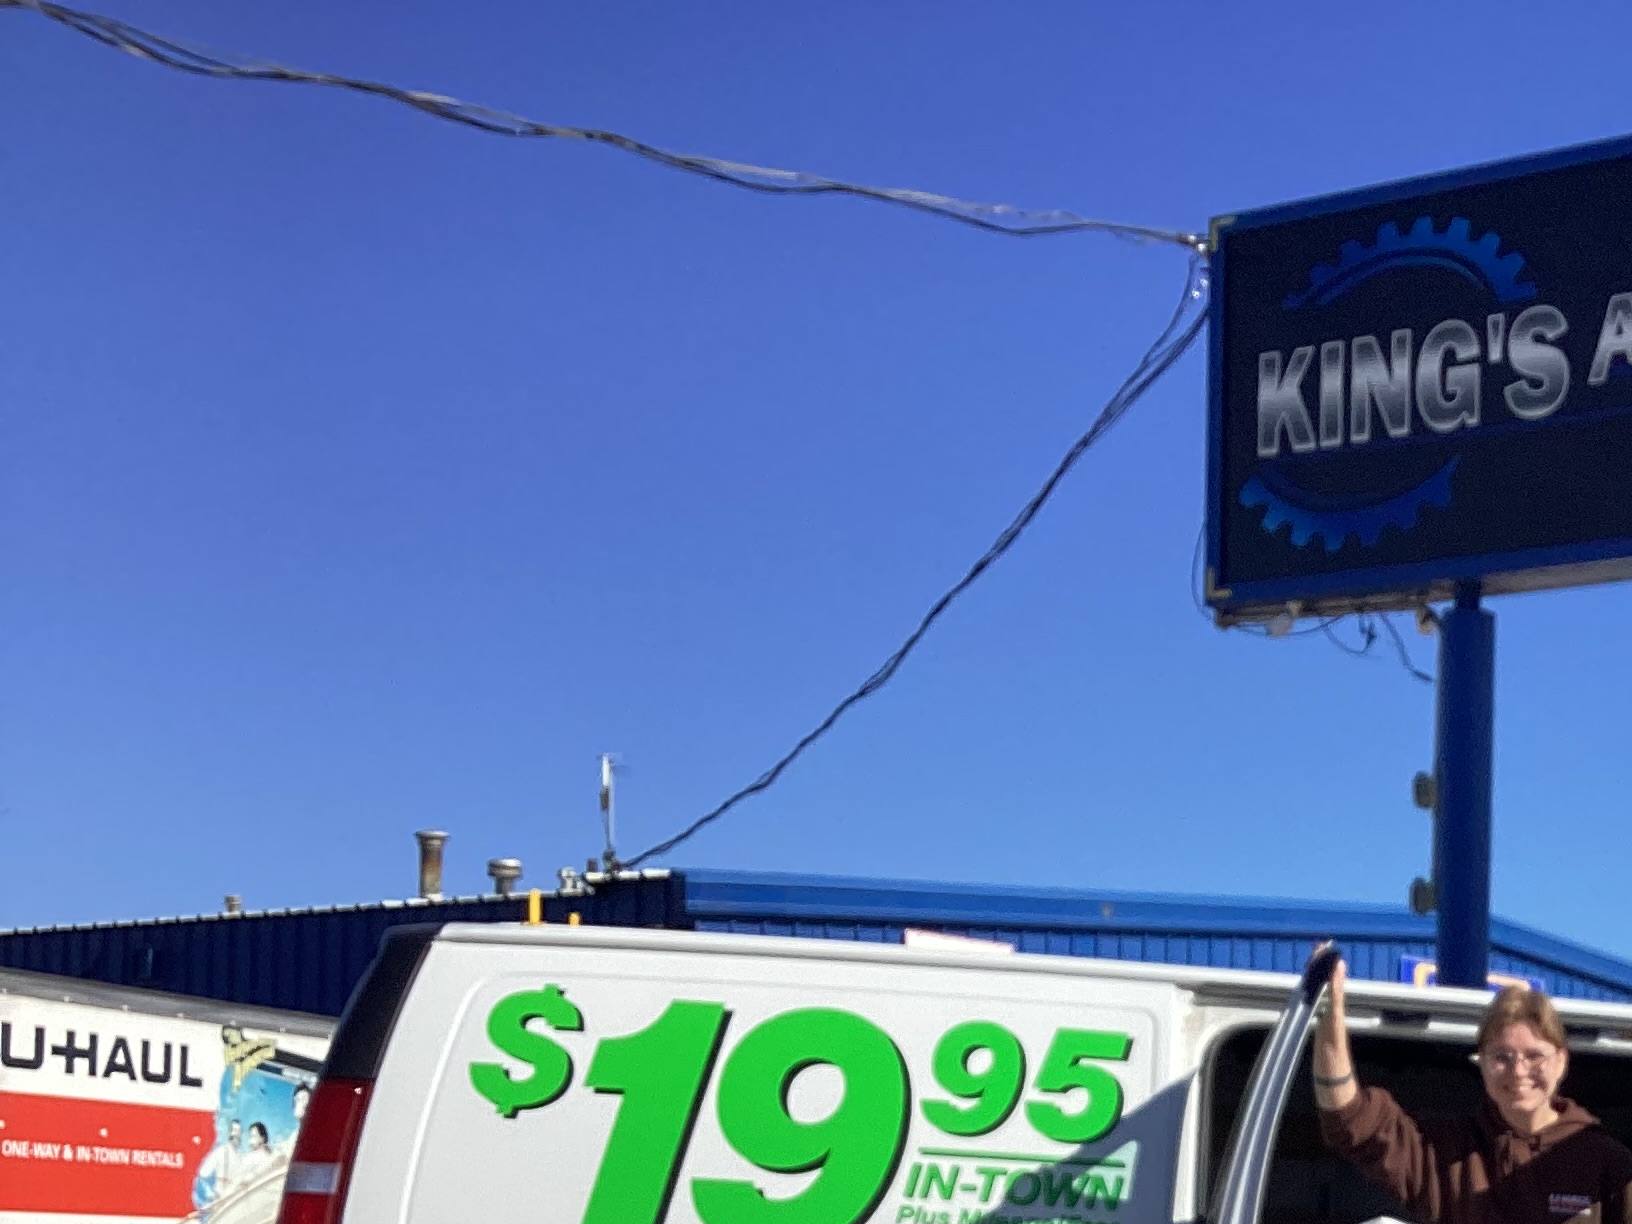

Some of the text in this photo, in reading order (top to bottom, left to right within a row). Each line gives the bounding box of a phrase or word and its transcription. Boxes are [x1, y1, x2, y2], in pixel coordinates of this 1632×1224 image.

[1257, 304, 1570, 457] KING'S
[1, 1021, 204, 1088] U-HAUL
[2, 1139, 184, 1169] ONE-WAY & IN-TOWN RENTALS
[902, 1161, 1125, 1211] IN-TOWN
